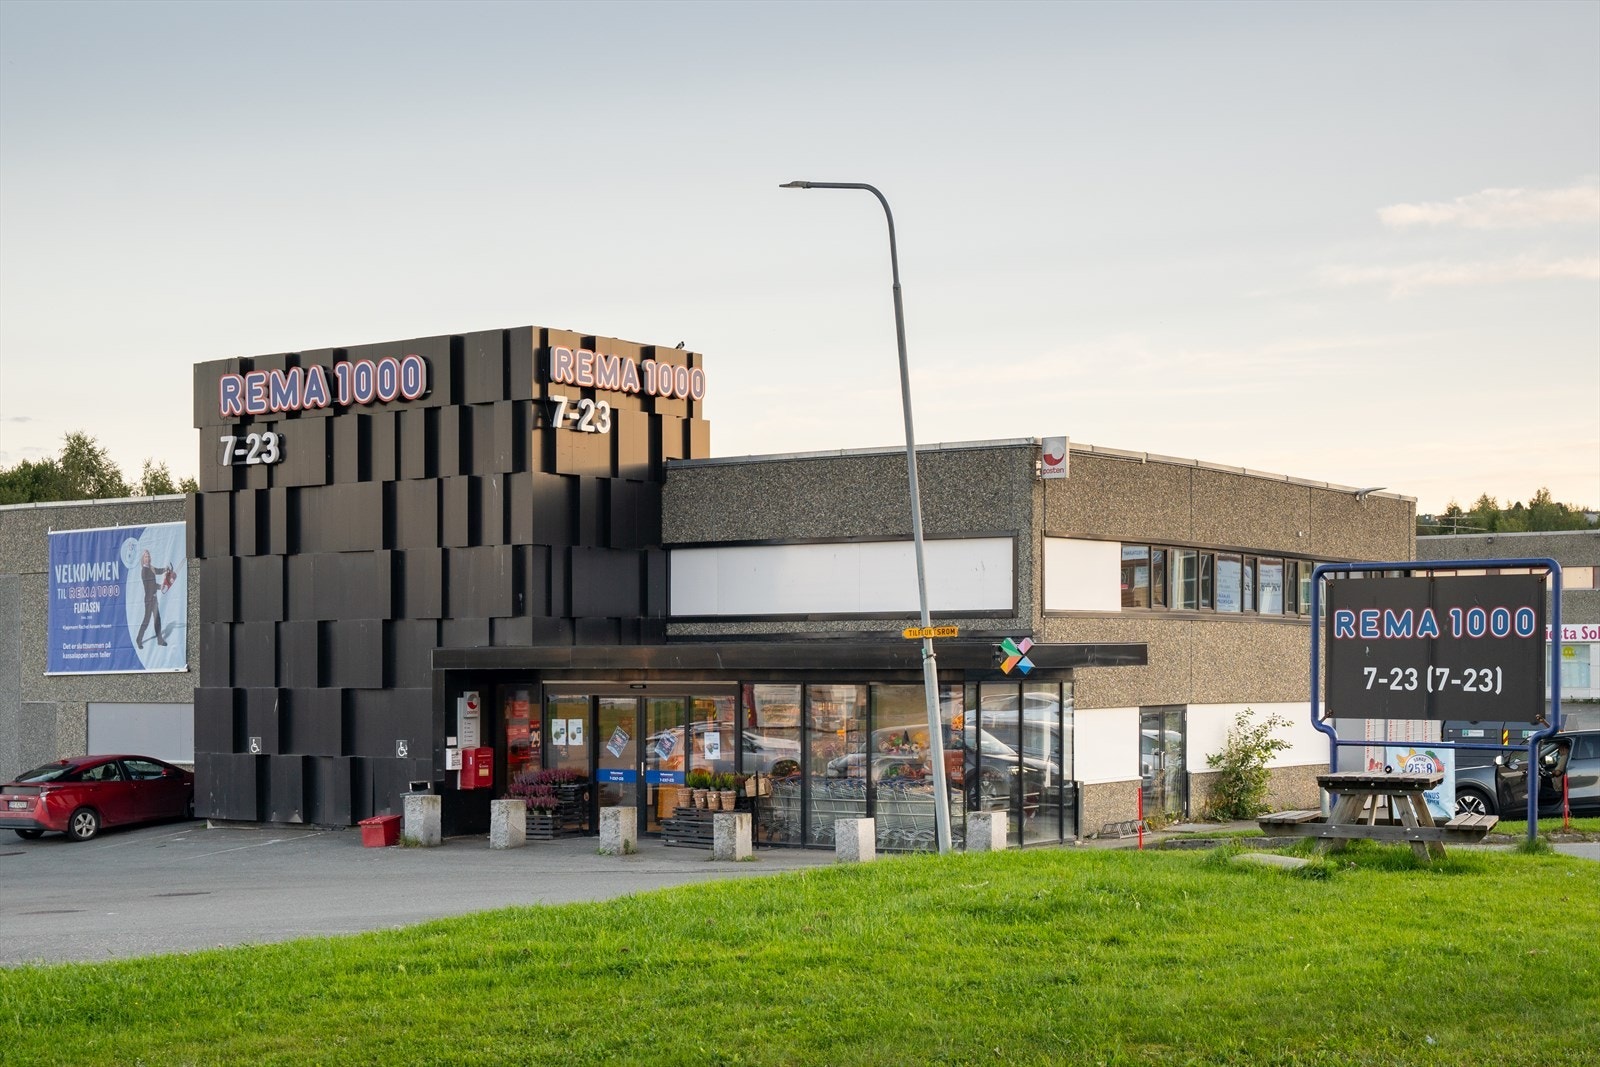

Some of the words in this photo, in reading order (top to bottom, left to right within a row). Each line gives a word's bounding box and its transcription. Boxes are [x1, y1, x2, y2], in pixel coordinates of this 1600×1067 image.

[219, 364, 331, 417] REMA
[334, 354, 426, 406] 1000
[551, 346, 640, 393] REMA
[641, 359, 705, 401] 1000
[550, 395, 611, 434] 7-23
[220, 431, 280, 466] 7-23
[1042, 467, 1065, 475] posten
[55, 560, 120, 584] VELKOMMEN
[57, 588, 67, 600] TIL
[69, 586, 97, 599] REMA
[97, 584, 120, 598] 1000
[73, 599, 101, 614] FLATÅSEN
[1334, 608, 1440, 639] REMA
[1449, 606, 1536, 639] 1000
[1363, 667, 1418, 691] 7-23
[1426, 665, 1503, 695] (7-23)
